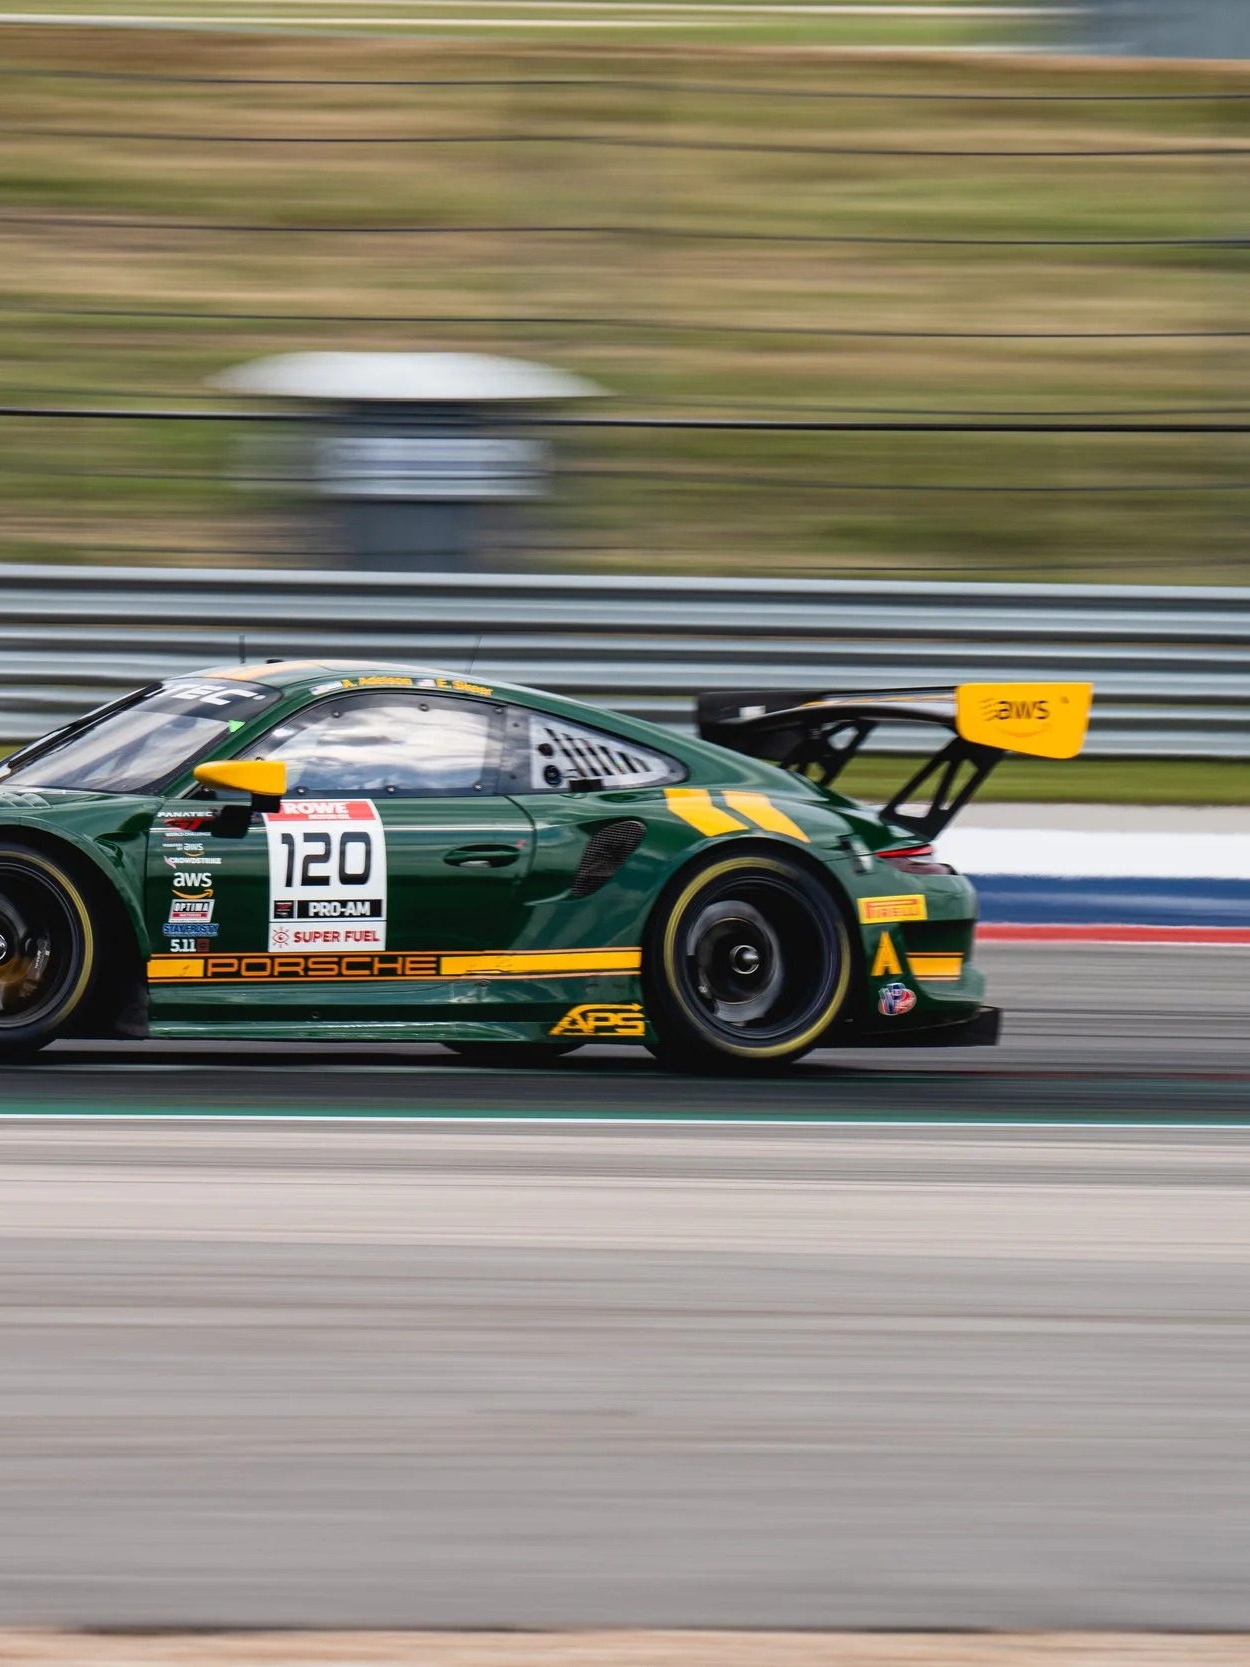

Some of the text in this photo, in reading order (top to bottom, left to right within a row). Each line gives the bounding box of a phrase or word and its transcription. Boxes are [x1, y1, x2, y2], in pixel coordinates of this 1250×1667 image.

[998, 700, 1050, 720] aws
[281, 802, 349, 814] ROWE
[281, 831, 372, 887] 120
[173, 872, 212, 887] aws
[173, 902, 209, 912] OPTIMA
[309, 901, 370, 916] PRO-AM
[294, 930, 381, 943] SUPER FUEL
[170, 939, 197, 952] 5.11
[206, 956, 438, 977] PORSCHE
[549, 1003, 646, 1036] APS
